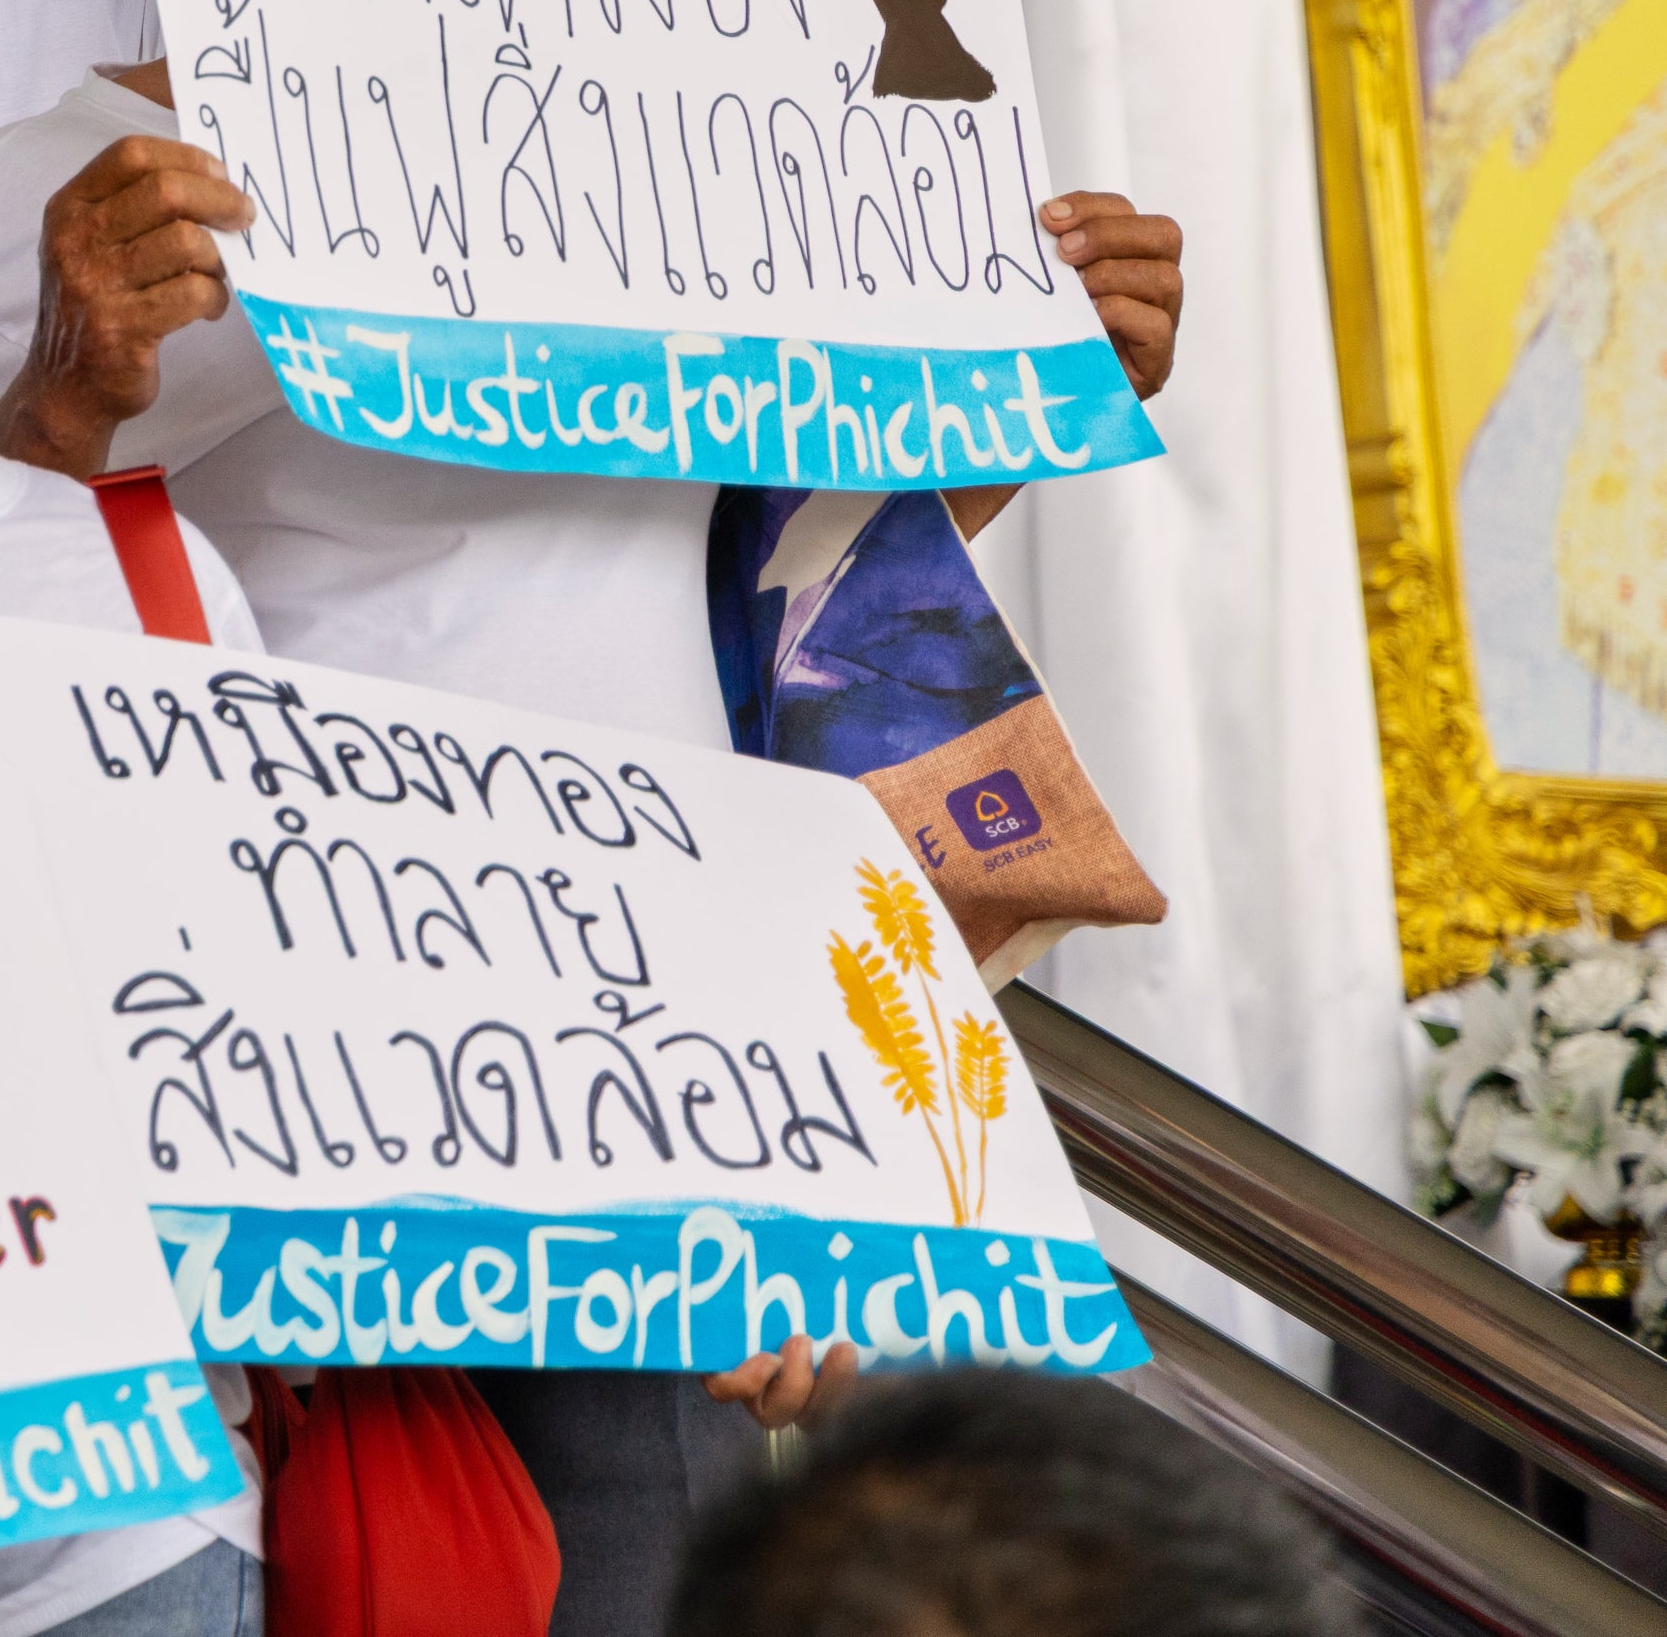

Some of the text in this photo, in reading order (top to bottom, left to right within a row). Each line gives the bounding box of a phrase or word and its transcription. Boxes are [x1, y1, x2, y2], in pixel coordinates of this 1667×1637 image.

[268, 315, 1092, 482] #JusticeForPhichit
[71, 670, 703, 863] เหมืองทอง
[984, 816, 1021, 839] SCB
[229, 806, 651, 987] ทำลาย
[982, 836, 1054, 874] SCB EASY
[111, 927, 878, 1178] สิ่งแวดล้อม
